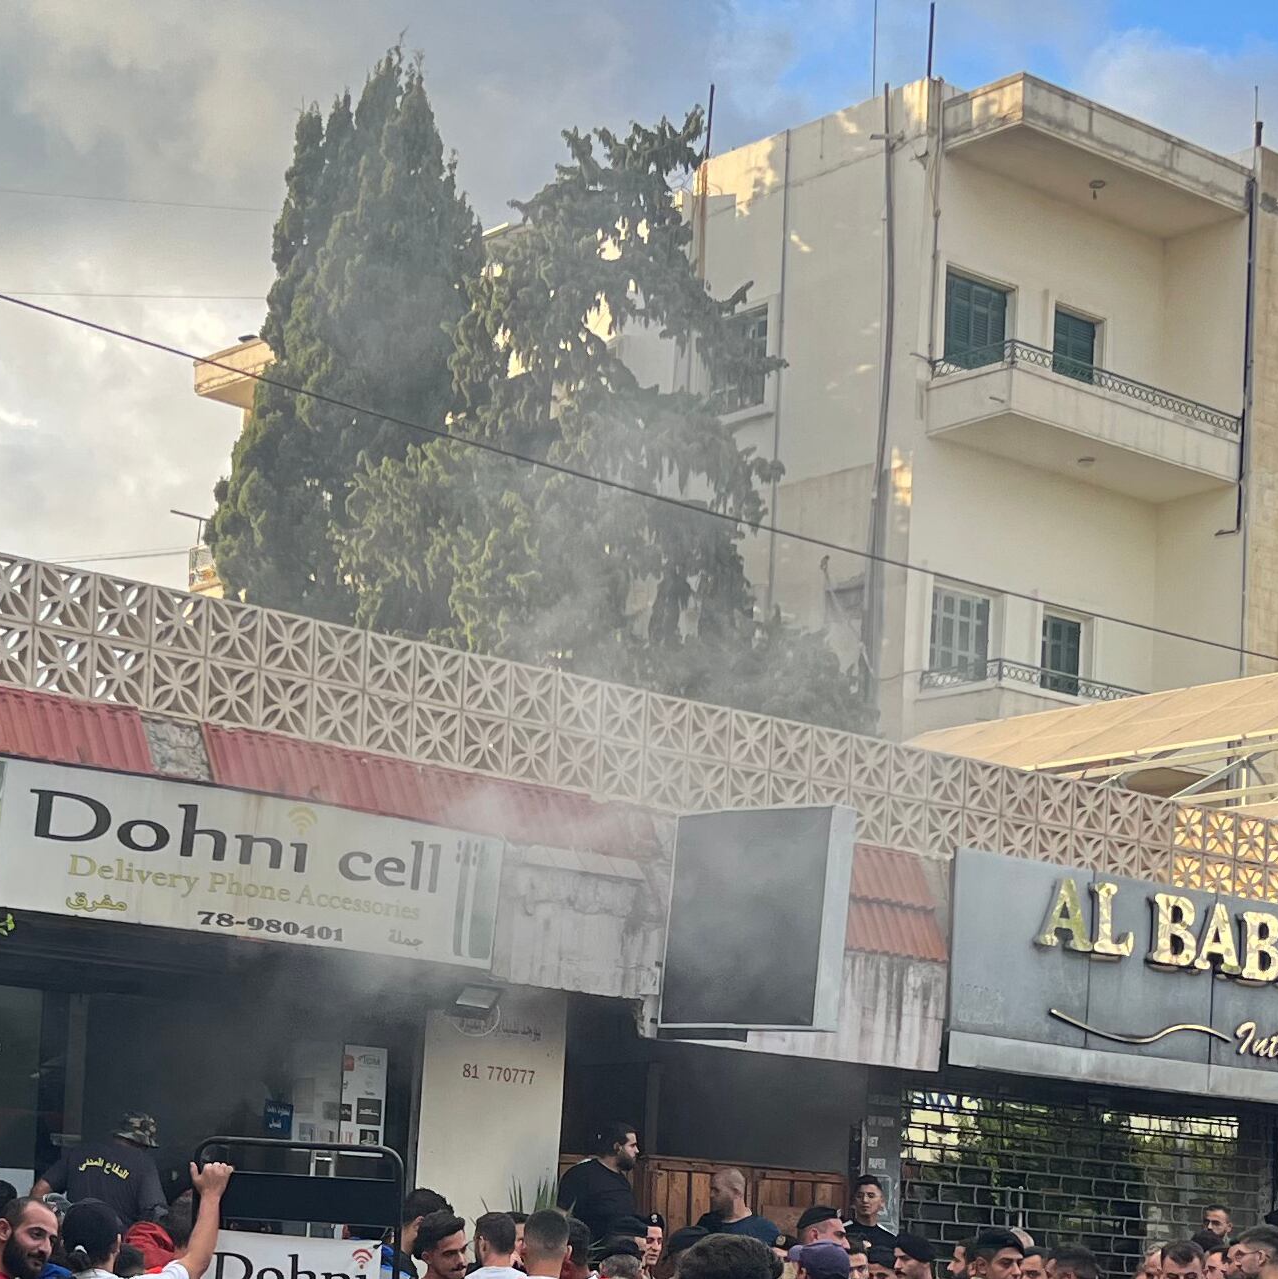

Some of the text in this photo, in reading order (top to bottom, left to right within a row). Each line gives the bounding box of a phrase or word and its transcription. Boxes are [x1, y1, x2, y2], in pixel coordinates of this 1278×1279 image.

[30, 787, 441, 895] Dohni cell
[65, 891, 128, 913] مفرق
[68, 853, 421, 921] Delivery Phone Accessories
[196, 910, 345, 943] 78-980401
[1033, 878, 1136, 963] AL
[387, 928, 424, 950] جملة
[462, 1063, 536, 1085] 81 770777
